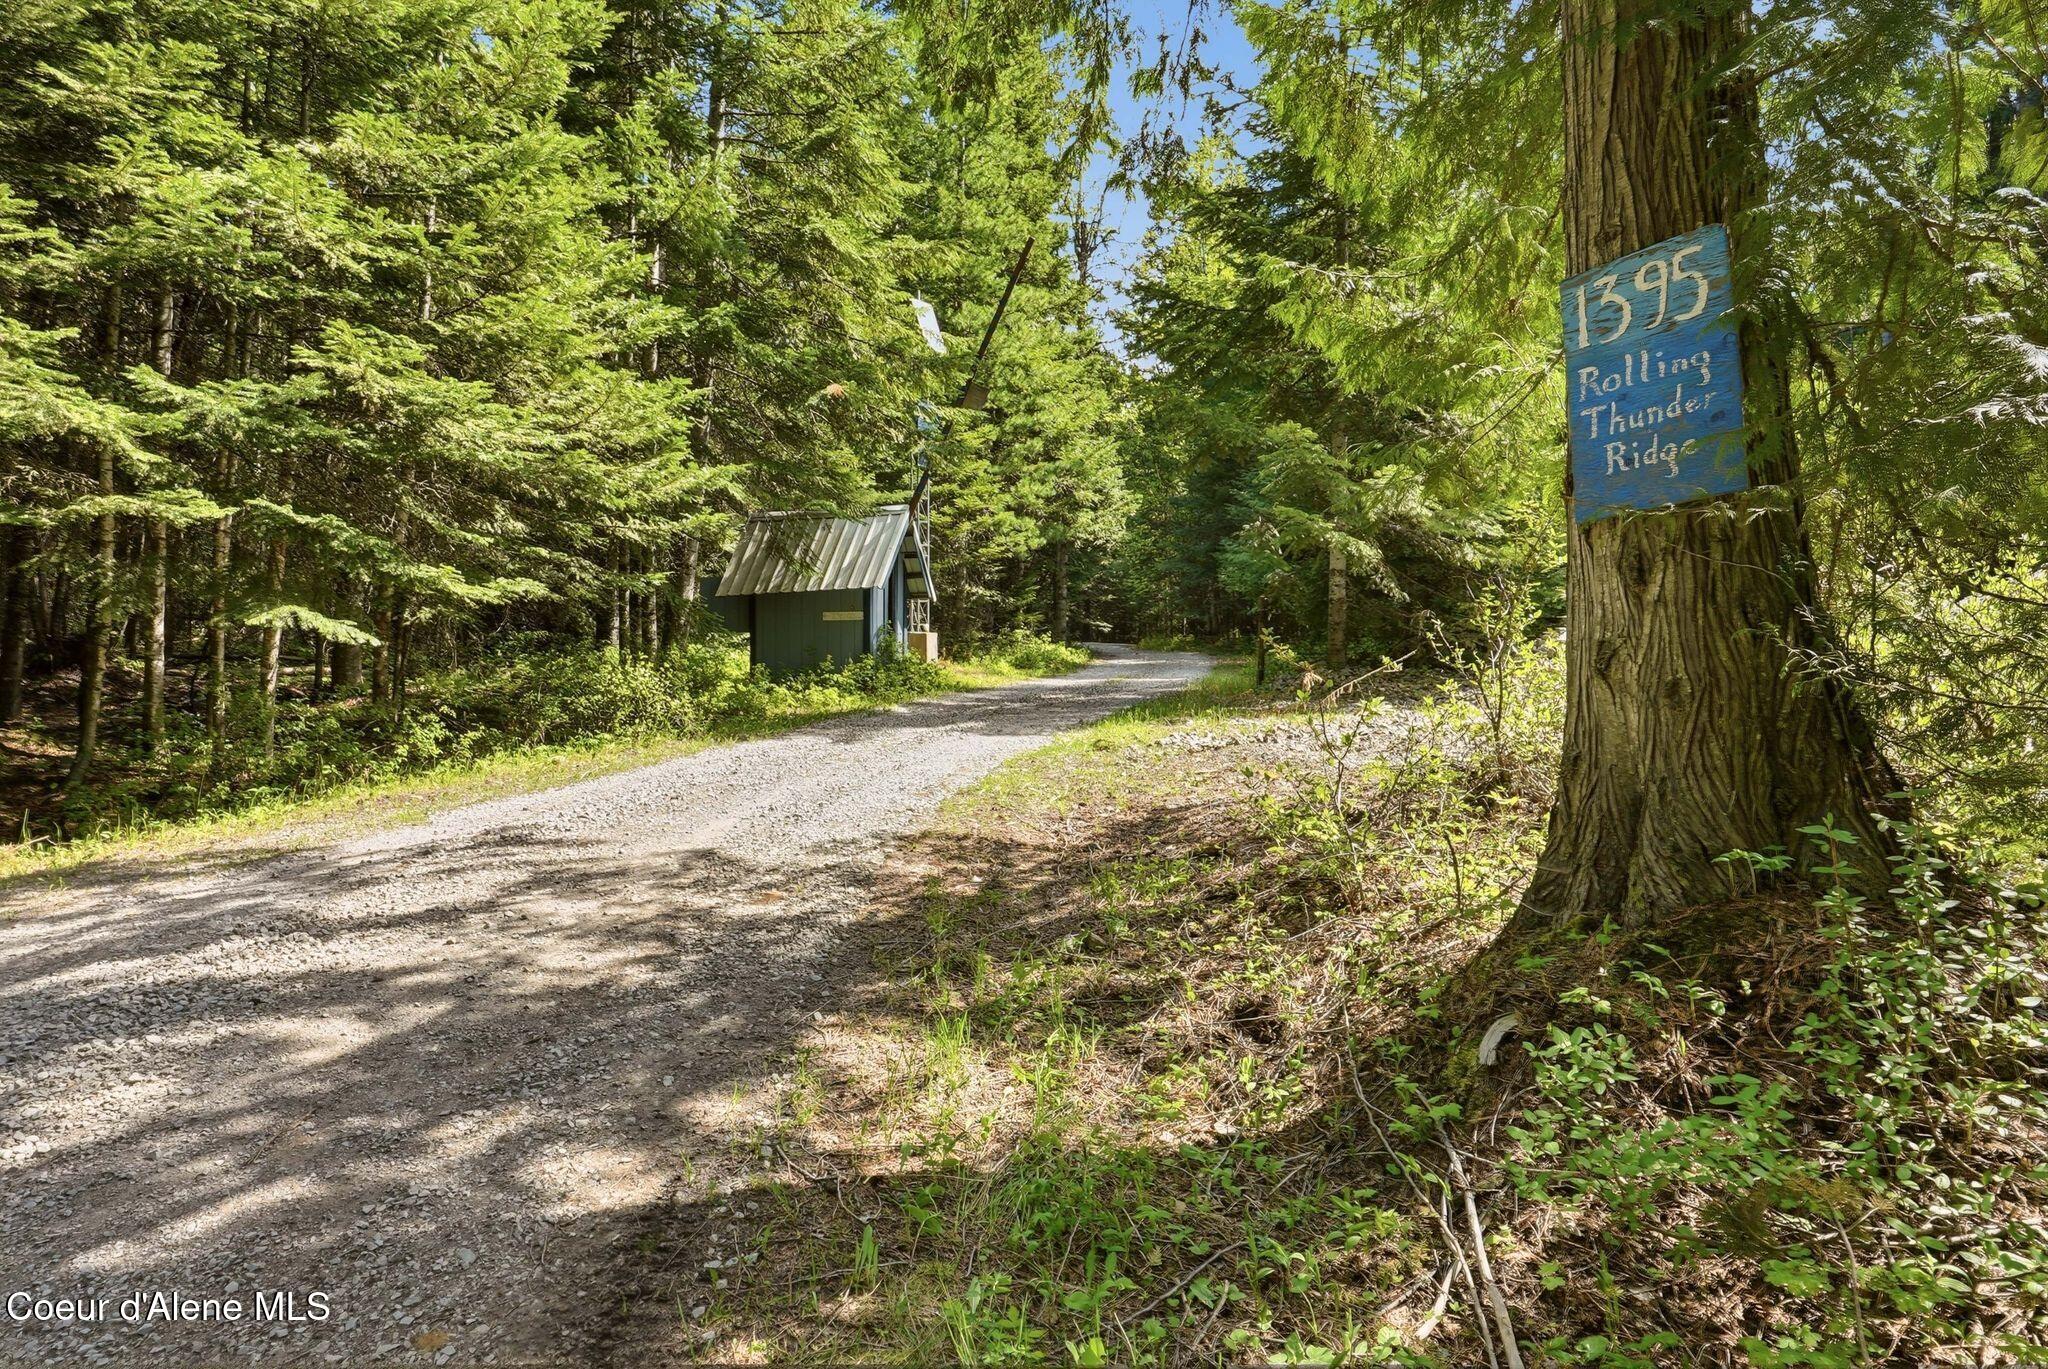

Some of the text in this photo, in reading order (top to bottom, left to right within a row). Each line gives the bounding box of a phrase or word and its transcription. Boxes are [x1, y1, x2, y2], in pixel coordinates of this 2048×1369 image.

[1577, 246, 1709, 350] 1395
[1577, 350, 1712, 402] Rolling
[1580, 383, 1717, 440] Thunder
[1603, 433, 1697, 478] Ridge
